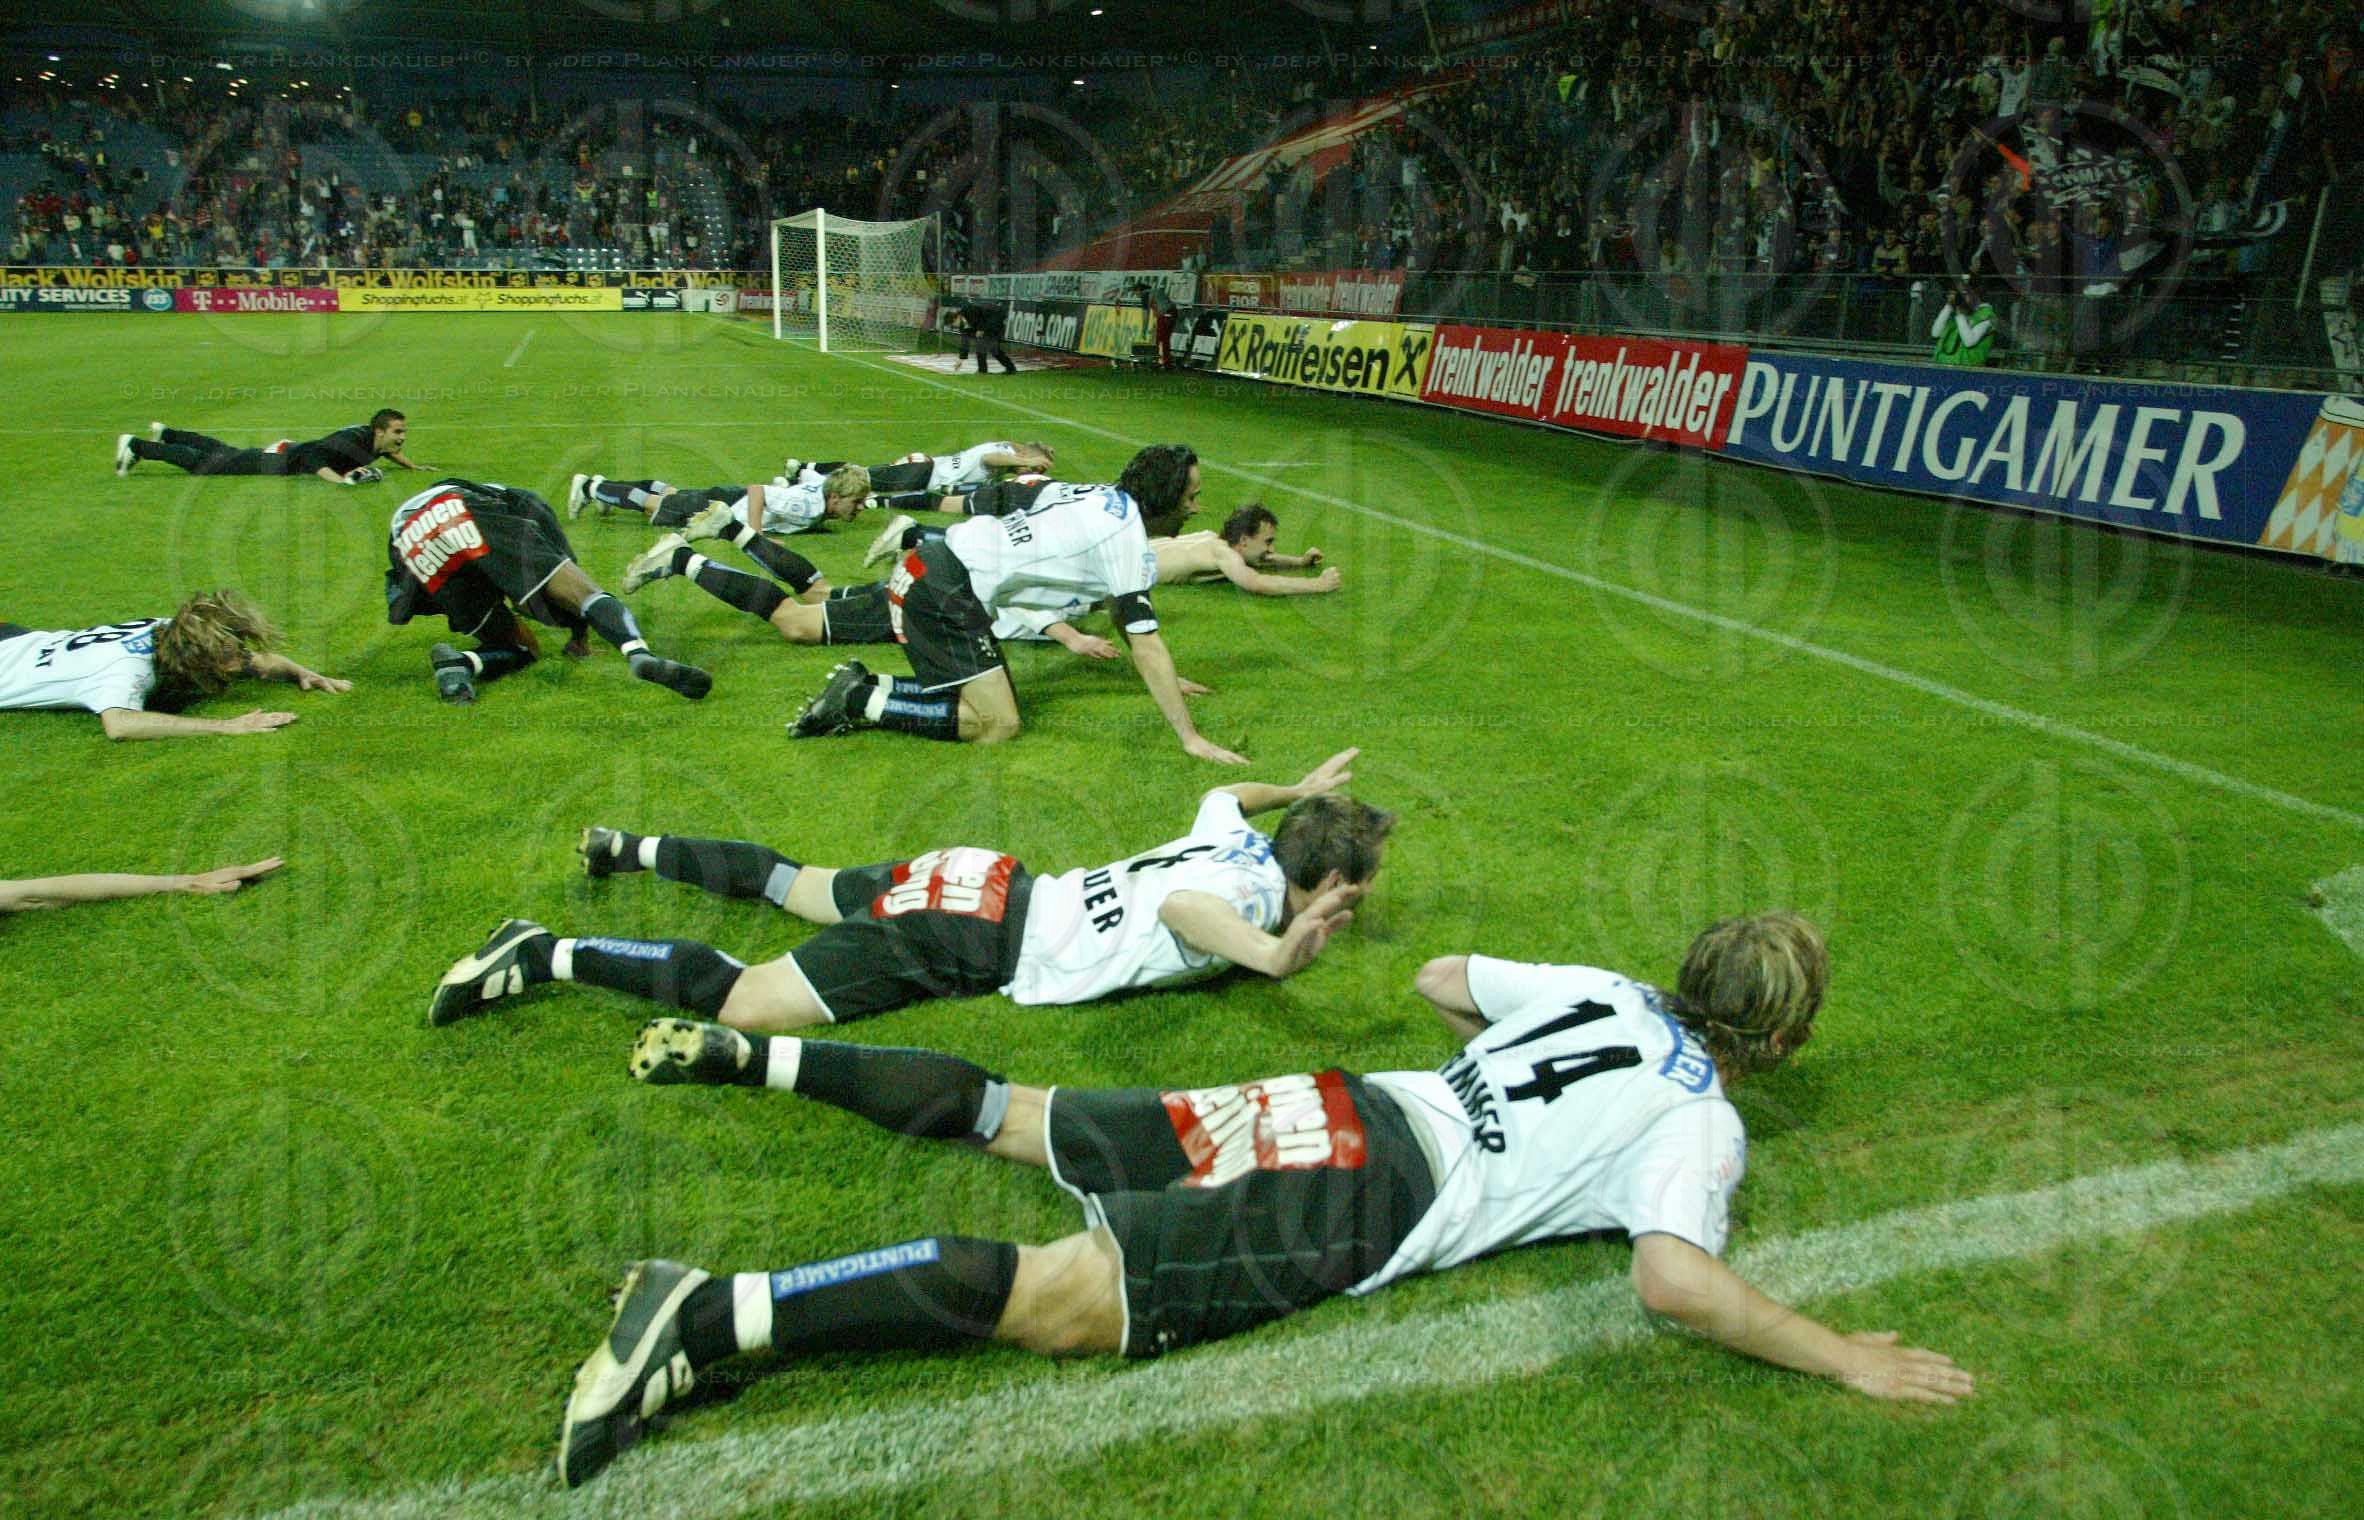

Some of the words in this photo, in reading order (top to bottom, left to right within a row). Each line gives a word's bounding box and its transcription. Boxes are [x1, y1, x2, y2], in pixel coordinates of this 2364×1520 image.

[0, 288, 31, 302] ITY
[38, 288, 130, 303] SERVICES
[63, 268, 184, 288] Wolfskin
[238, 292, 308, 310] Mobile
[324, 270, 382, 289] Jack
[387, 270, 498, 289] Wolfskin
[1245, 322, 1391, 391] Raiffeisen
[1427, 332, 1553, 412] trenkwalder
[1559, 338, 1732, 443] trenkwalder
[1727, 364, 2246, 521] PUNTIGAMER
[1485, 998, 1643, 1106] 14
